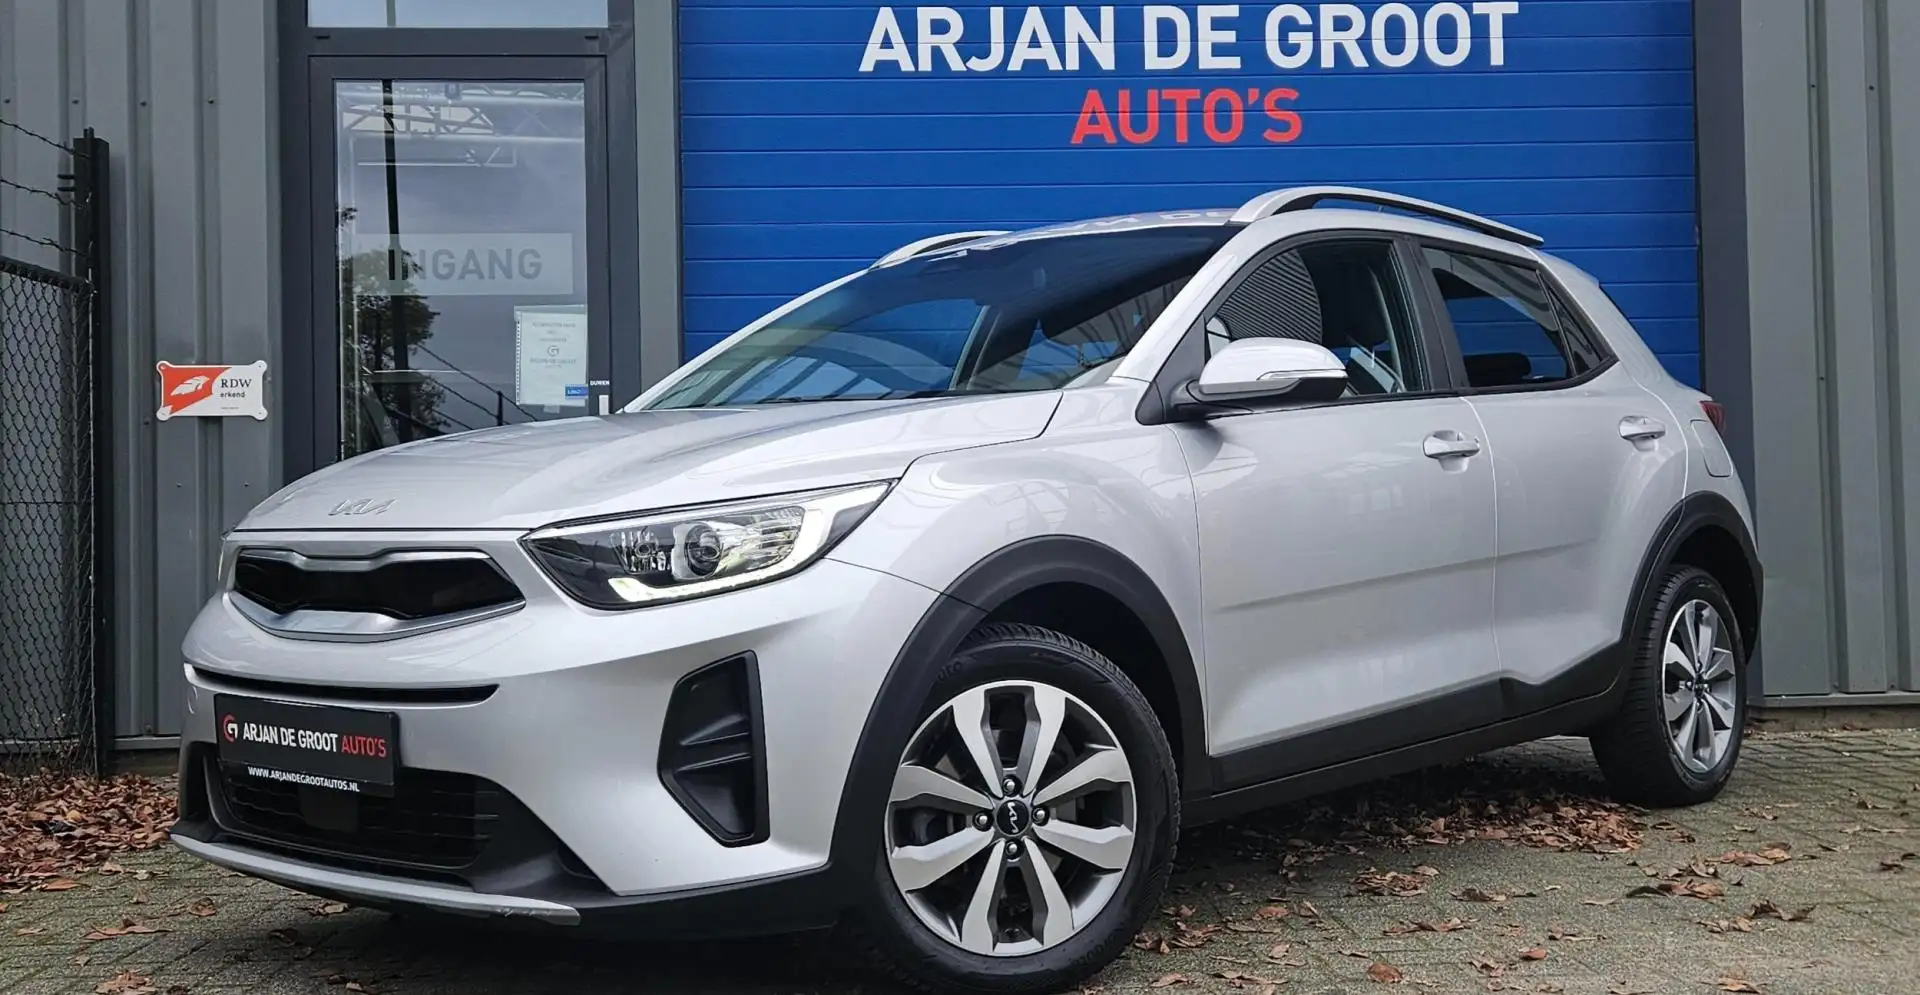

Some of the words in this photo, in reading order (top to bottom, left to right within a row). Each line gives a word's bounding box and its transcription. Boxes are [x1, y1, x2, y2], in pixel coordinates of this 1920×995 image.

[858, 5, 1115, 73] ARJAN
[1144, 4, 1242, 70] DE
[1264, 2, 1519, 69] GROOT
[1070, 87, 1303, 145] AUTO'S
[388, 249, 542, 281] INGANG
[220, 378, 252, 388] RDW
[242, 722, 279, 744] ARJAN
[280, 727, 297, 747] DE
[297, 729, 339, 753] GROOT
[341, 735, 387, 758] AUTO'S
[248, 766, 361, 792] WWW.ARJANDEGROOTAUTOS.NL
